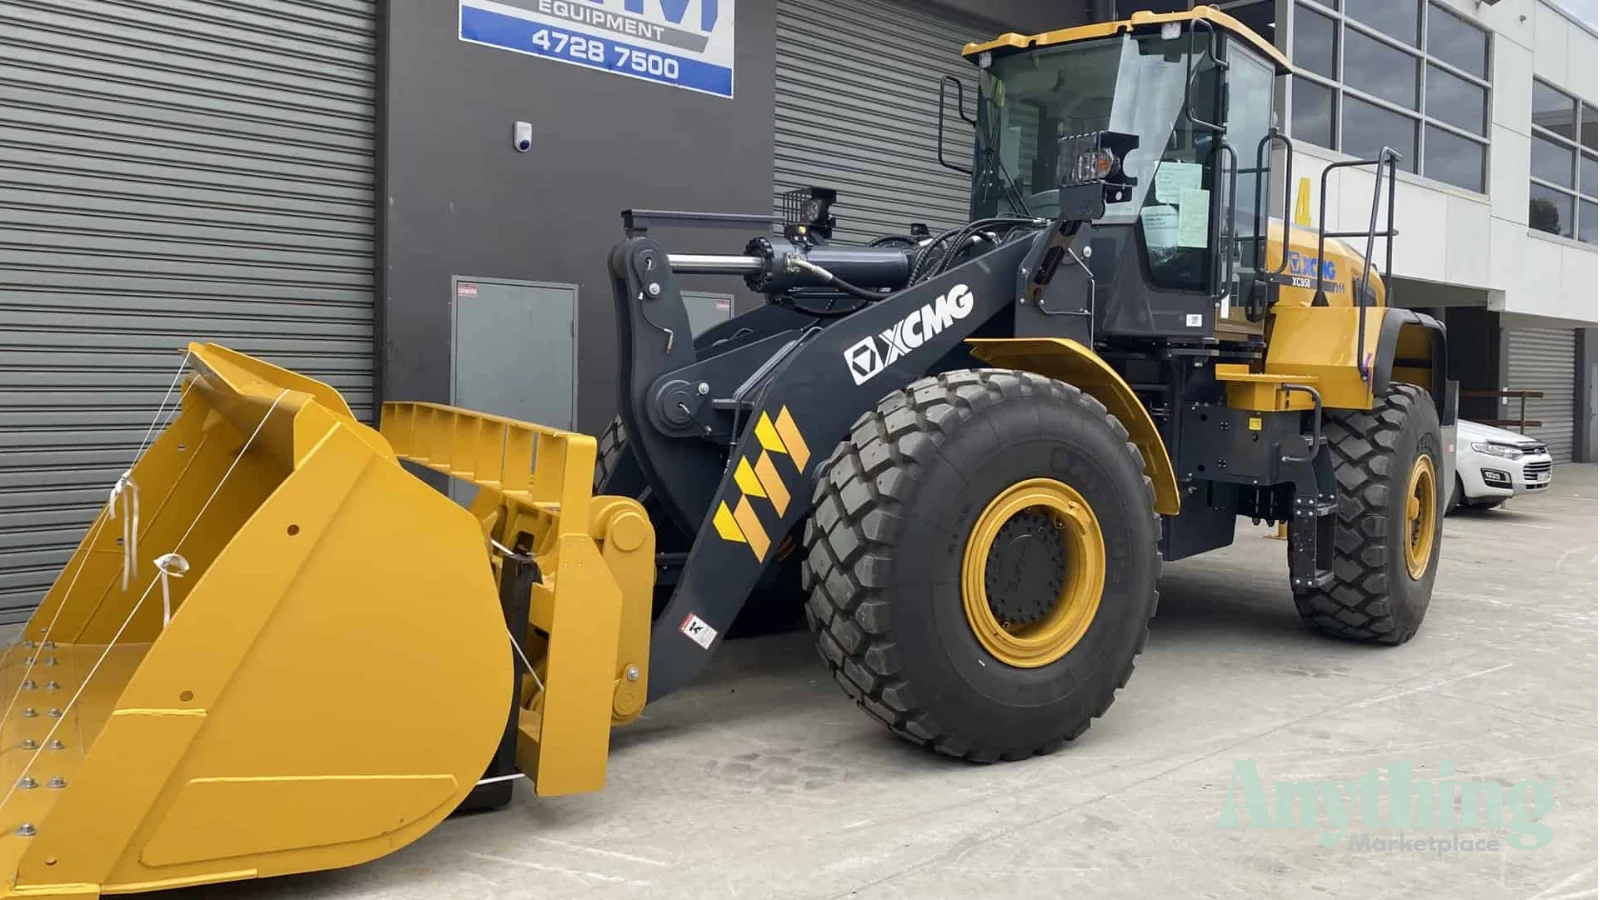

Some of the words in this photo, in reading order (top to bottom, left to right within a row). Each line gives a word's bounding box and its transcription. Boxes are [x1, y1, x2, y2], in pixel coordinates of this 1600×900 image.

[538, 0, 664, 41] EQUIPMENT
[532, 29, 605, 63] 4728
[614, 46, 680, 80] 7500
[878, 284, 974, 367] XCMG
